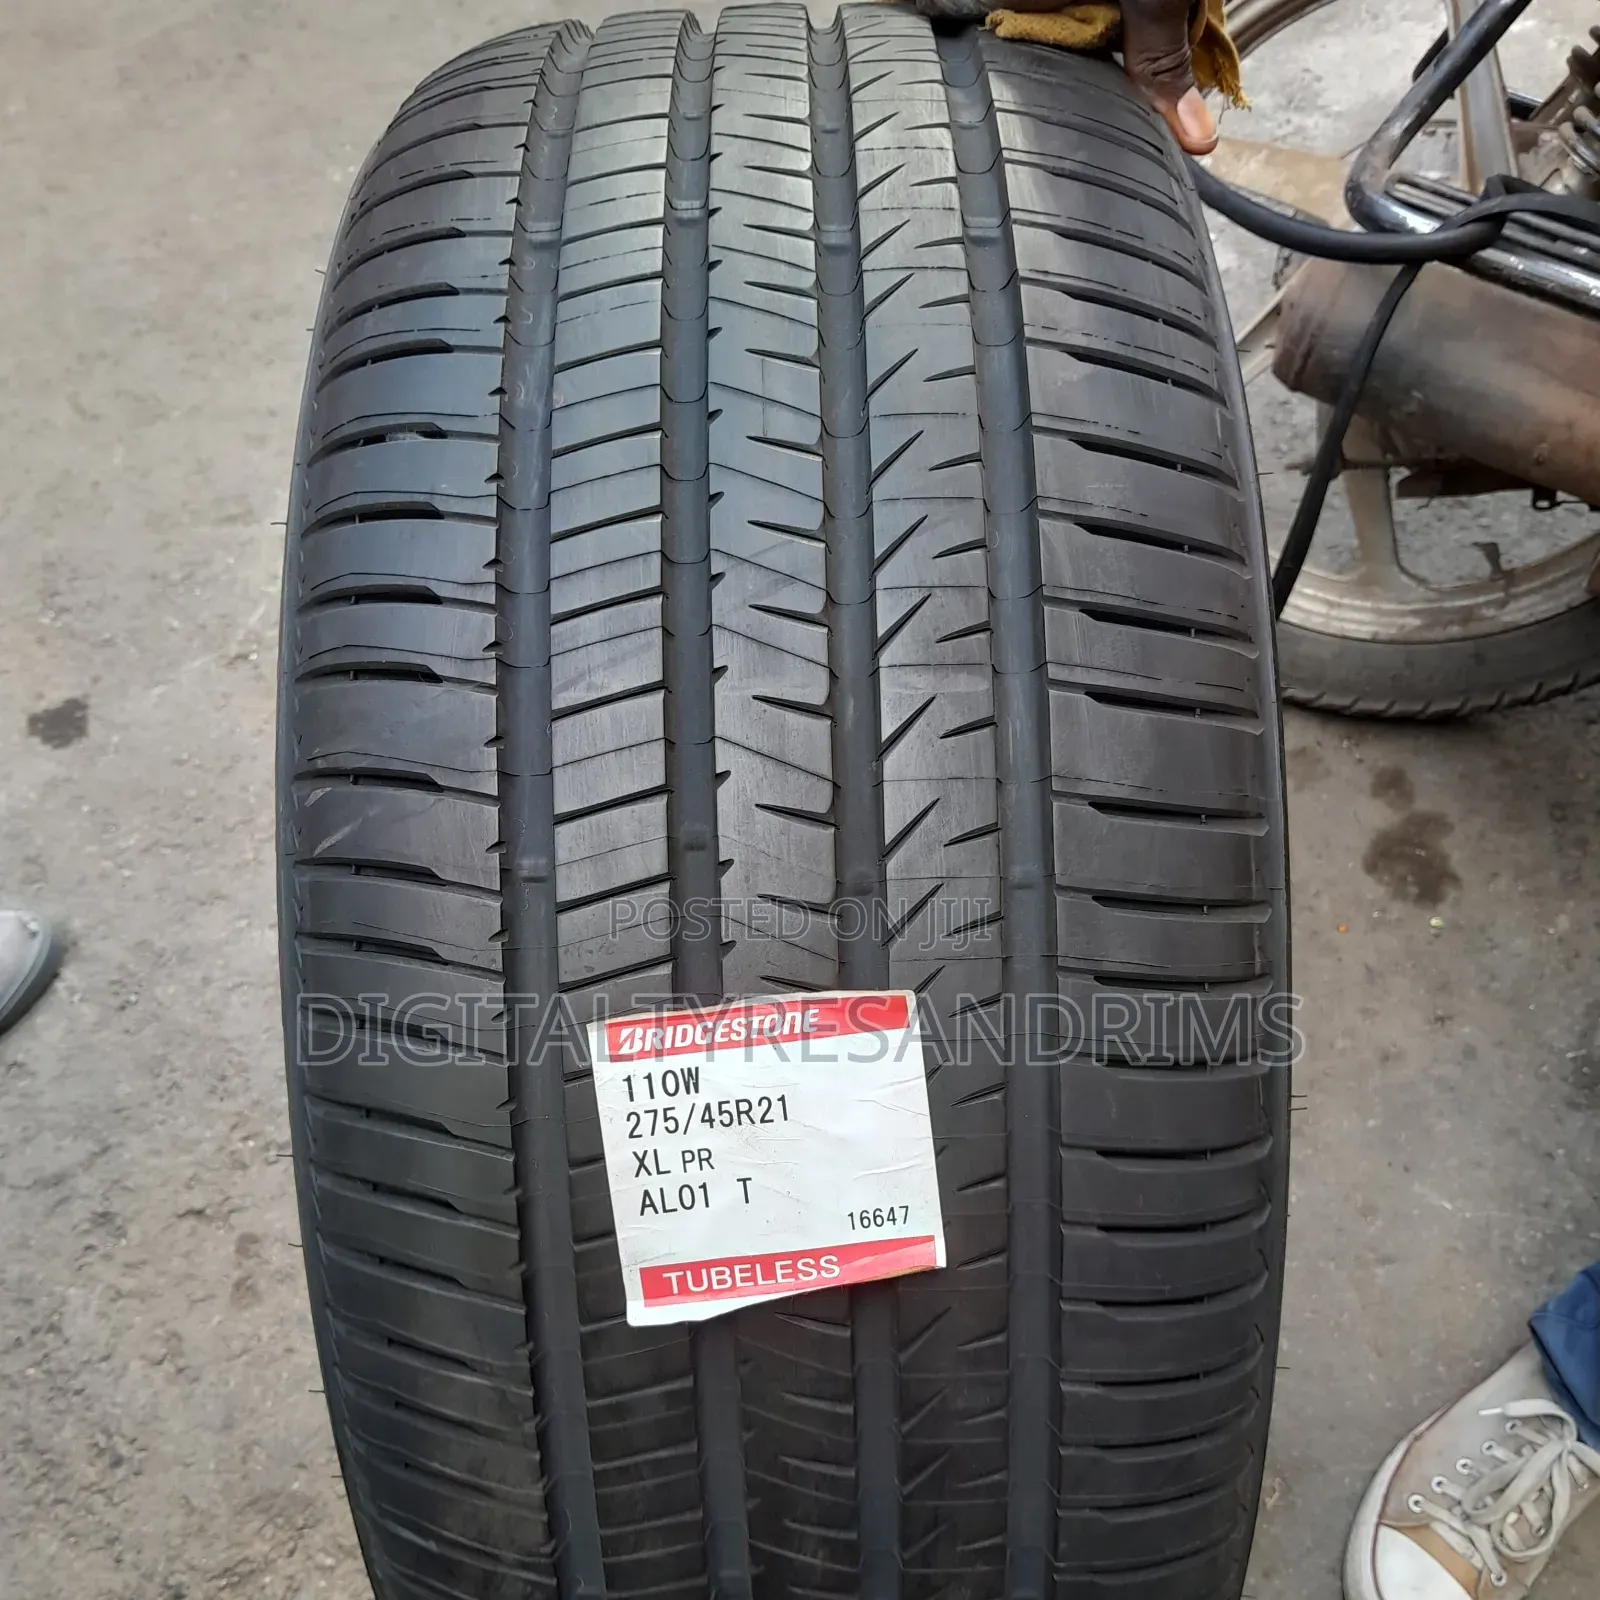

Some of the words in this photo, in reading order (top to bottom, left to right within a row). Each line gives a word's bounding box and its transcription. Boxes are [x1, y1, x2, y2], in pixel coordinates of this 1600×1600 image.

[619, 1008, 820, 1055] BRIDGESTONE
[623, 1066, 701, 1102] 110W
[626, 1094, 790, 1139] 275/45R21
[632, 1149, 671, 1178] XL
[682, 1148, 715, 1174] PR
[639, 1181, 711, 1216] AL01
[737, 1177, 752, 1204] T
[848, 1205, 910, 1230] 16647
[663, 1254, 841, 1295] TUBELESS
